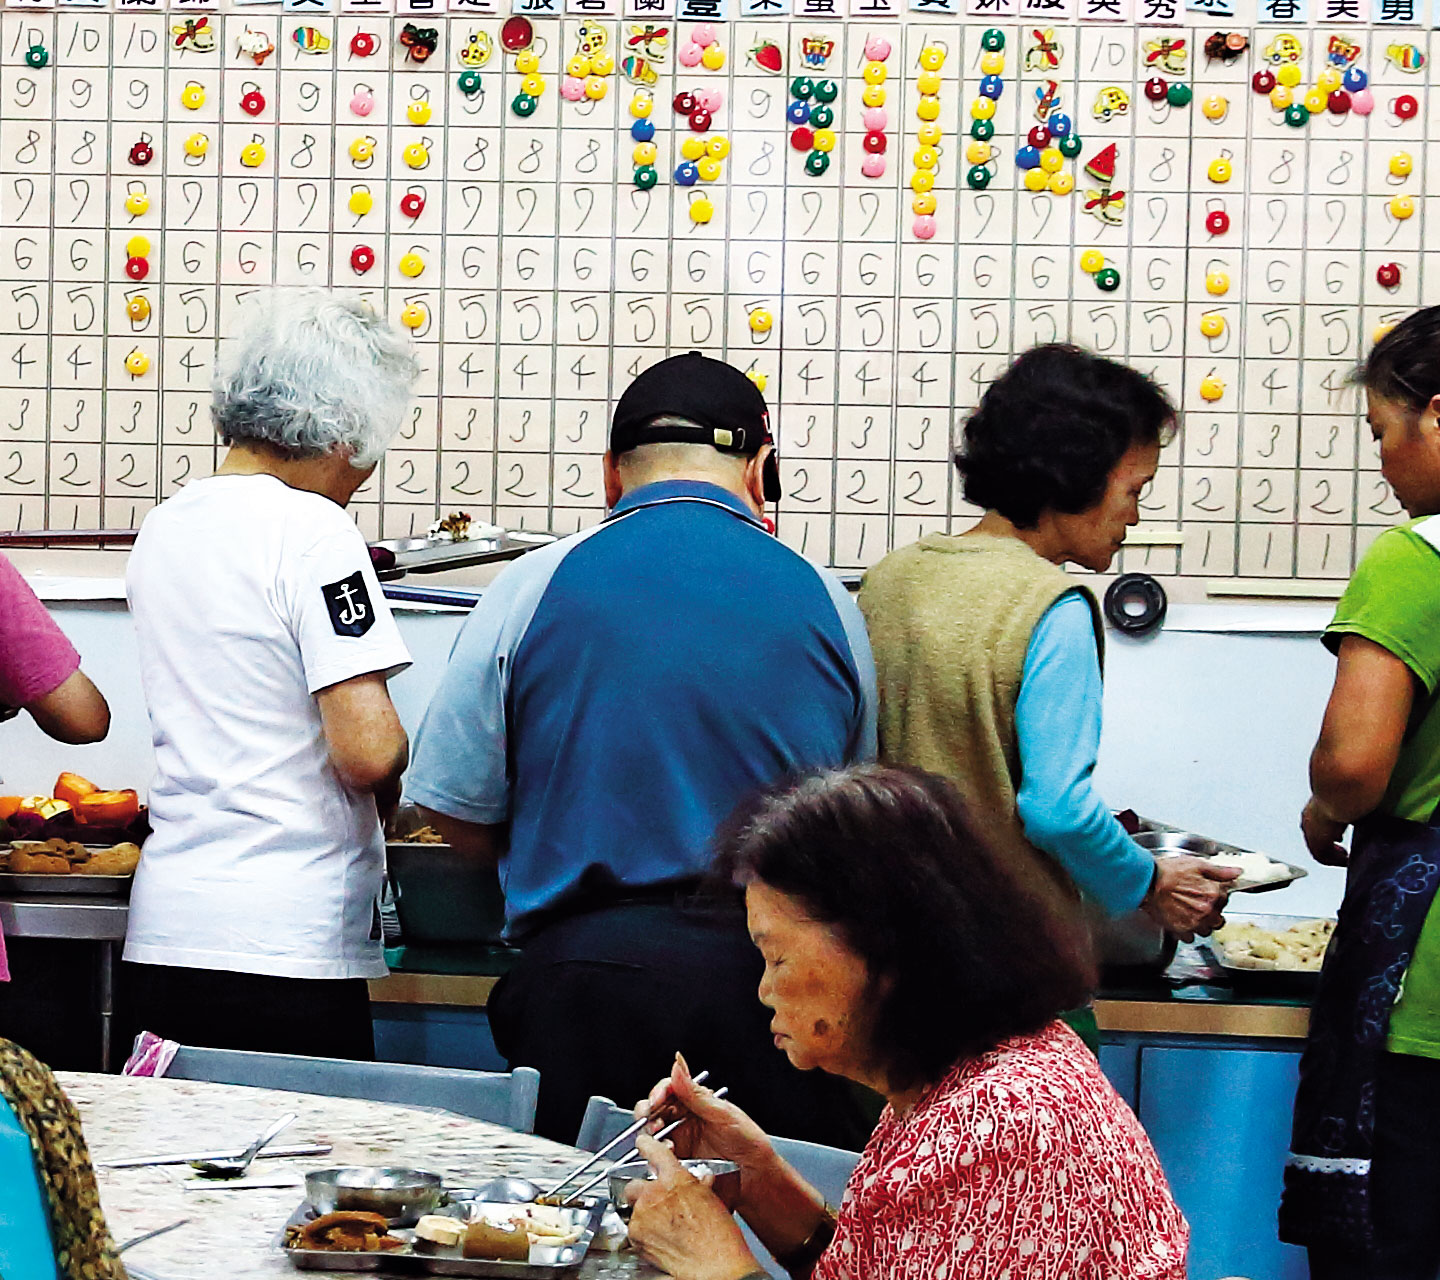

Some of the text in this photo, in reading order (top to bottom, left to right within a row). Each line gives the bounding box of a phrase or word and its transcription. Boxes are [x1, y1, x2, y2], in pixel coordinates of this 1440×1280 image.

[66, 21, 100, 58] 10
[124, 22, 158, 59] 10
[1091, 36, 1126, 77] 10
[14, 77, 37, 108] 9
[70, 77, 92, 108] 9
[298, 81, 321, 112] 9
[749, 87, 772, 119] 9
[1197, 421, 1219, 456] 3
[1191, 476, 1226, 512] 2
